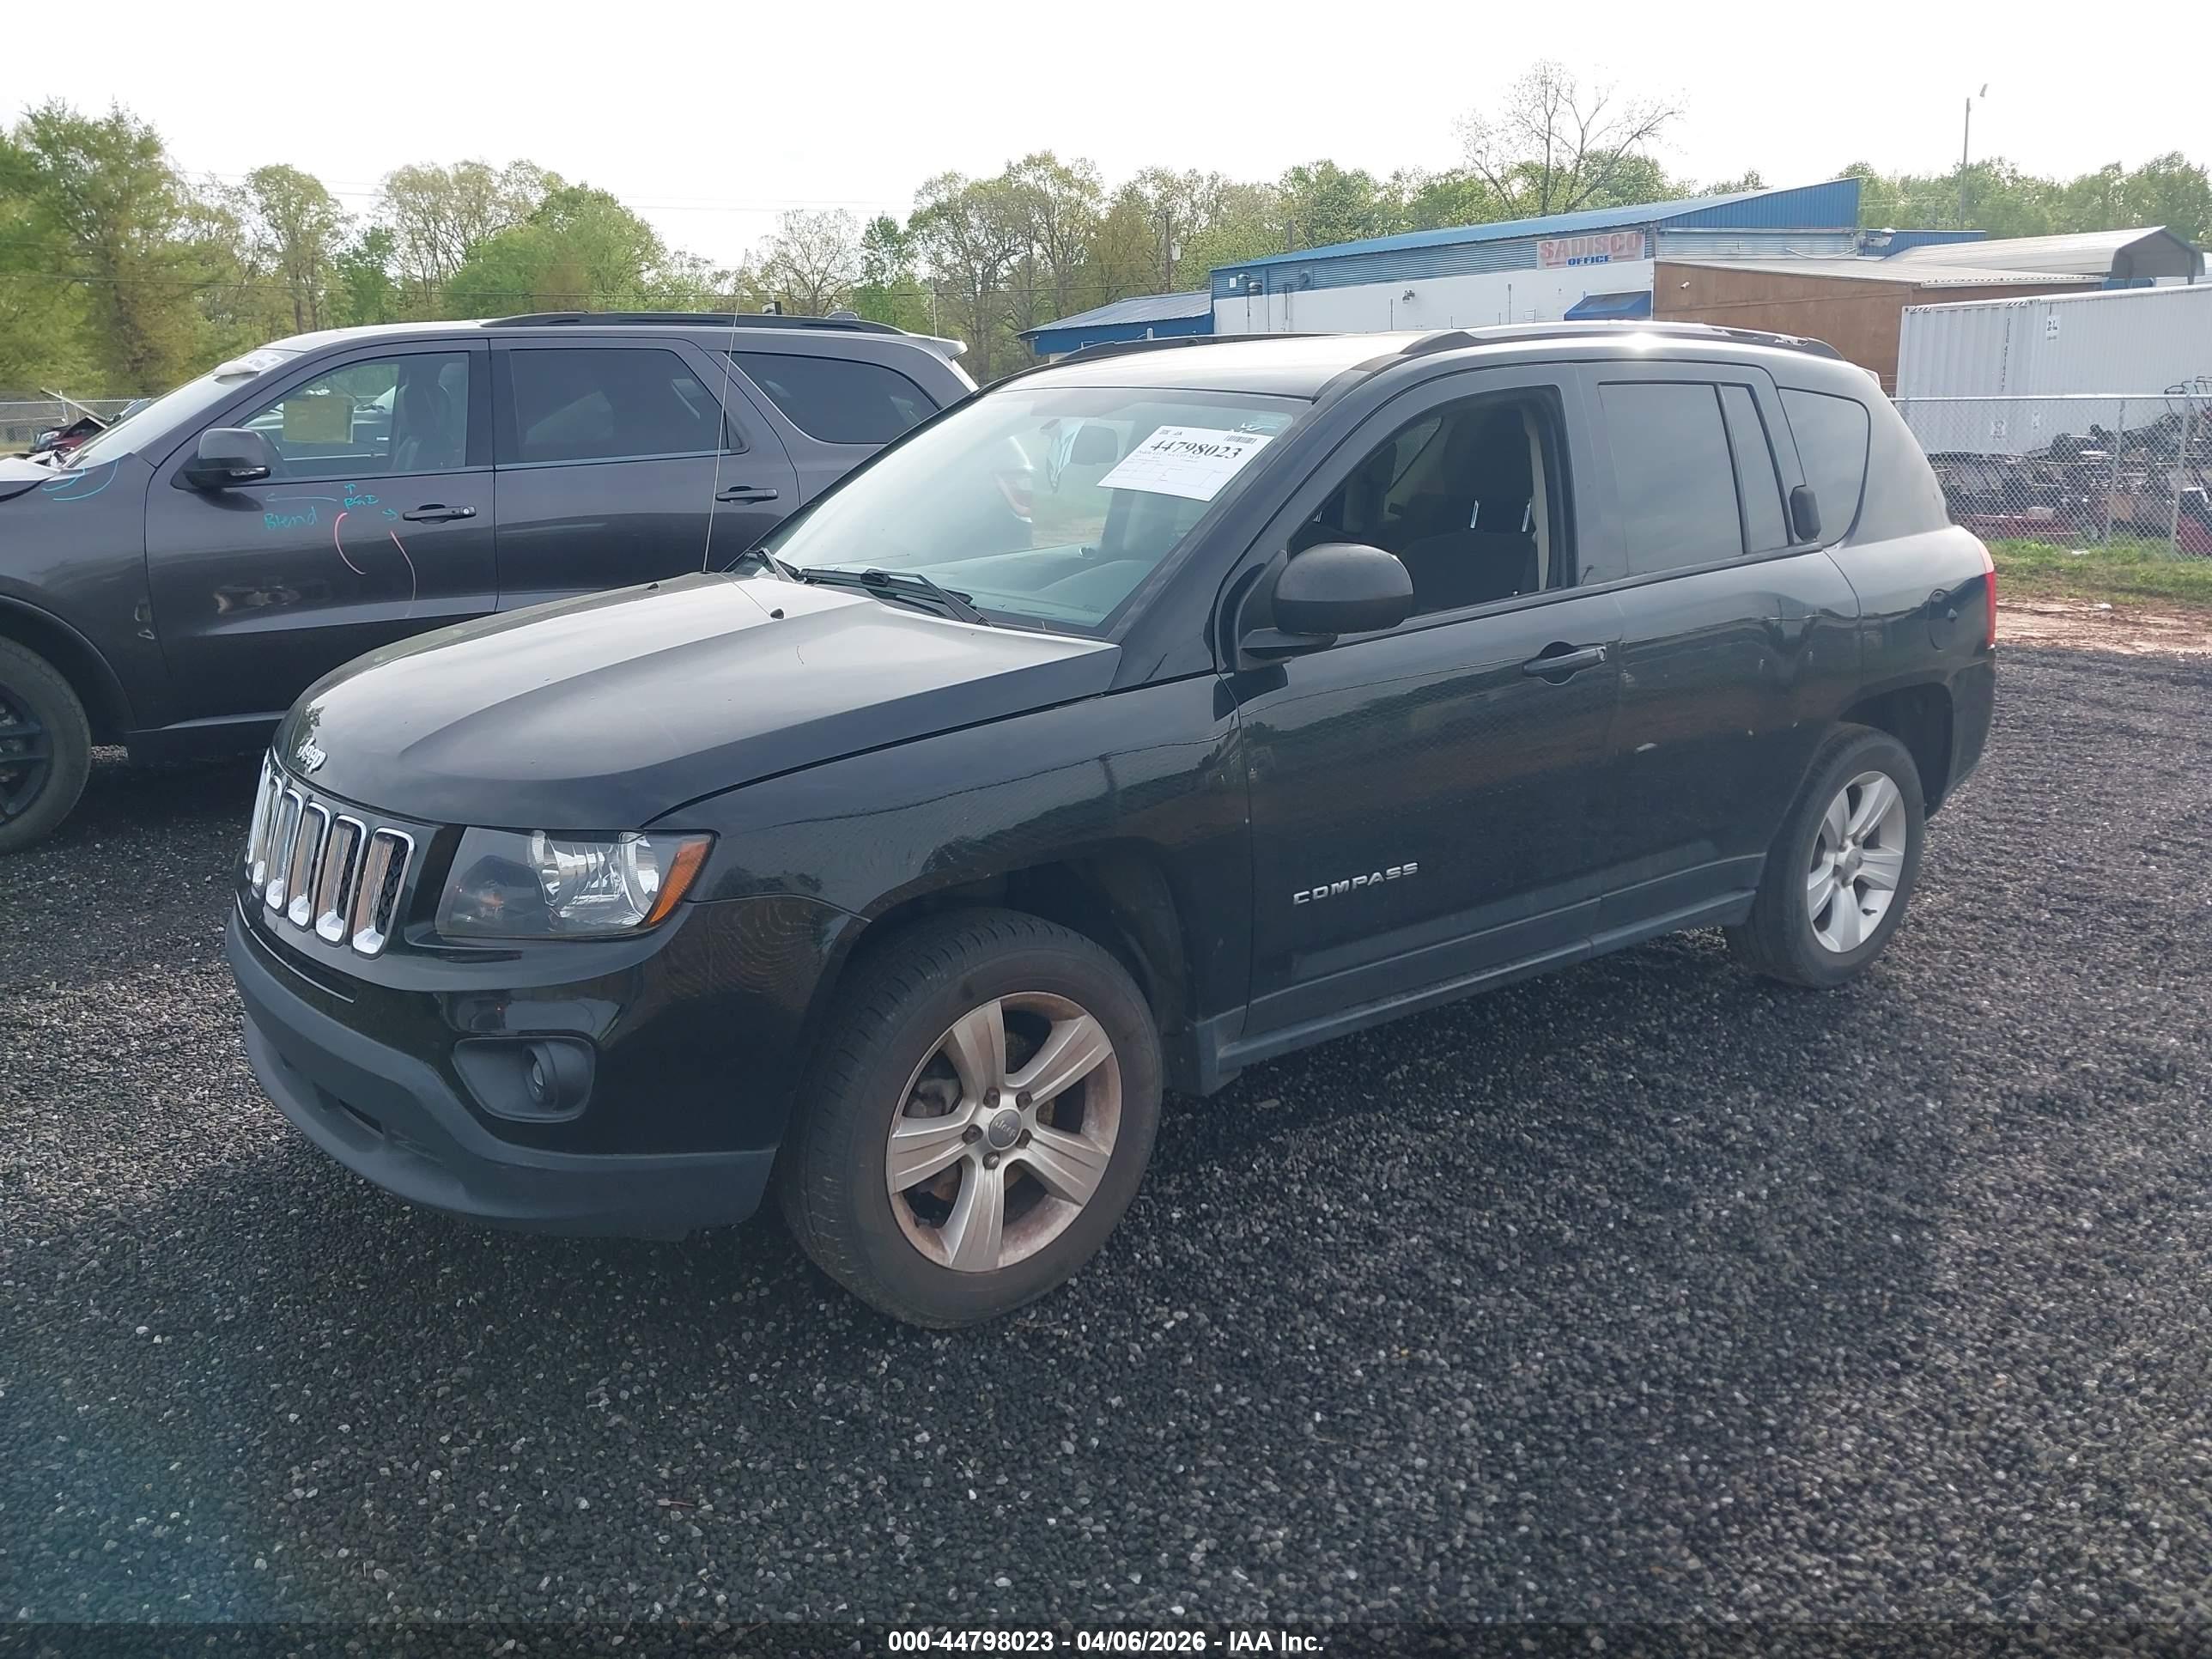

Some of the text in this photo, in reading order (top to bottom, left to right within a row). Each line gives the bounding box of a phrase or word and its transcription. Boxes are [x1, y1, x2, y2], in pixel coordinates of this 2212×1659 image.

[1540, 232, 1643, 258] SADISCO
[1567, 255, 1612, 266] OFFICE
[1150, 440, 1243, 459] 44798023
[295, 738, 326, 773] Jeep
[1293, 862, 1419, 905] COMPASS
